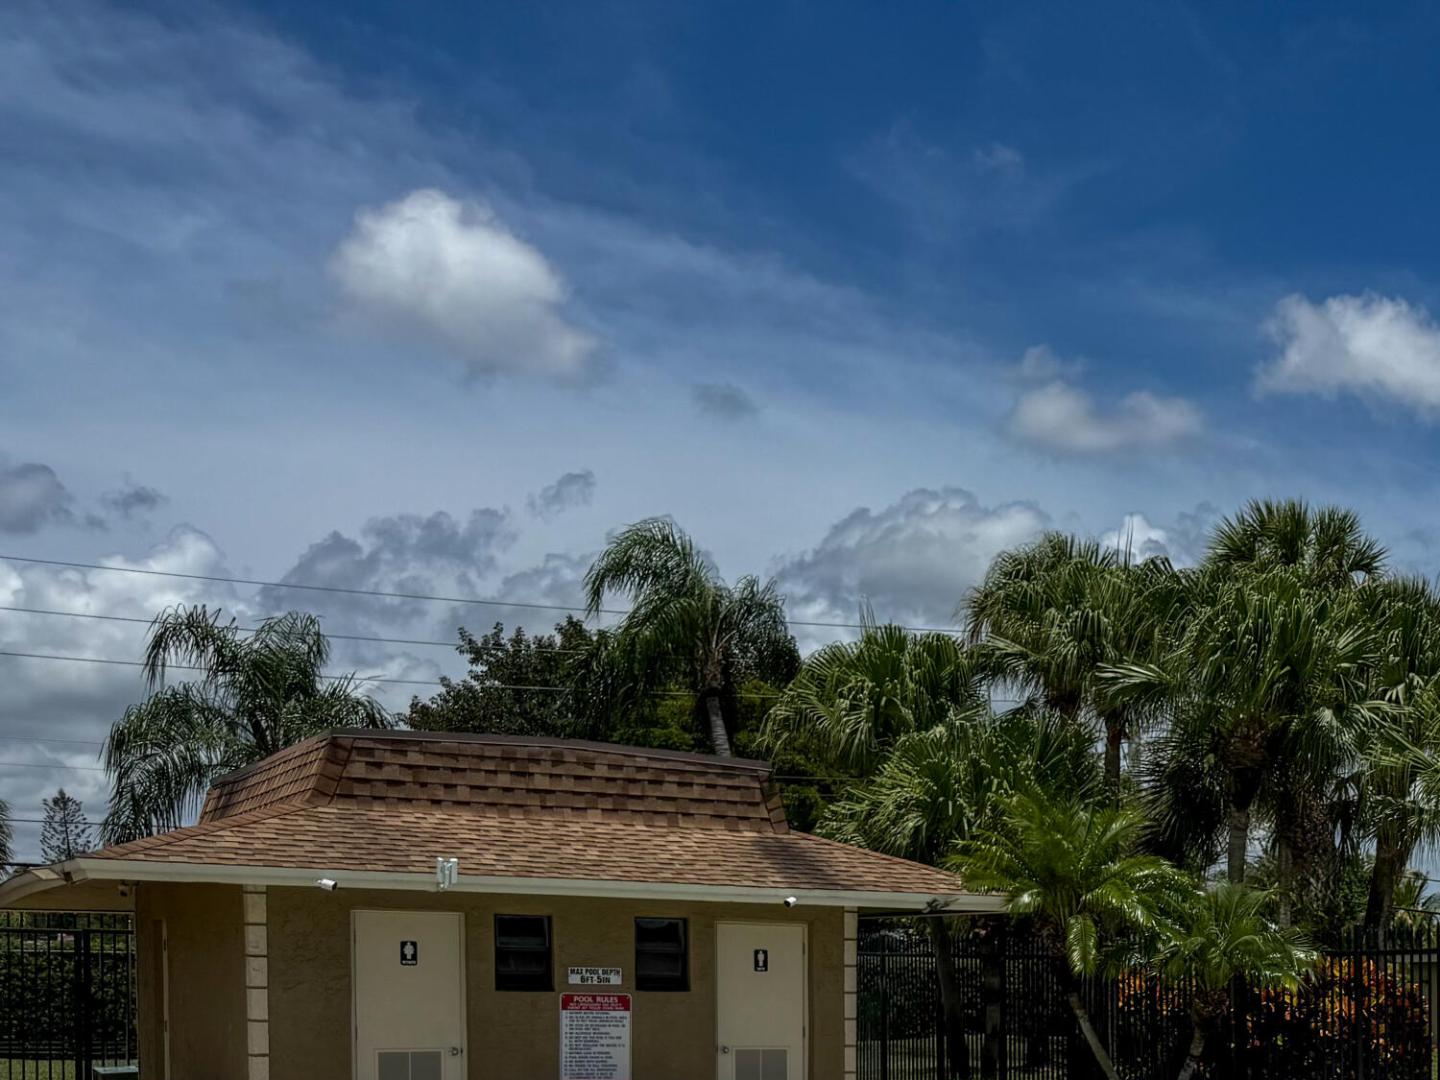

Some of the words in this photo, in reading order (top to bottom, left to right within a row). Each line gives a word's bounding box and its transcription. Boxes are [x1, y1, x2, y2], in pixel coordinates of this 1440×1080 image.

[585, 968, 599, 976] POOL
[601, 968, 621, 976] DEPTH
[573, 995, 593, 1003] POOL
[596, 995, 618, 1003] RULES
